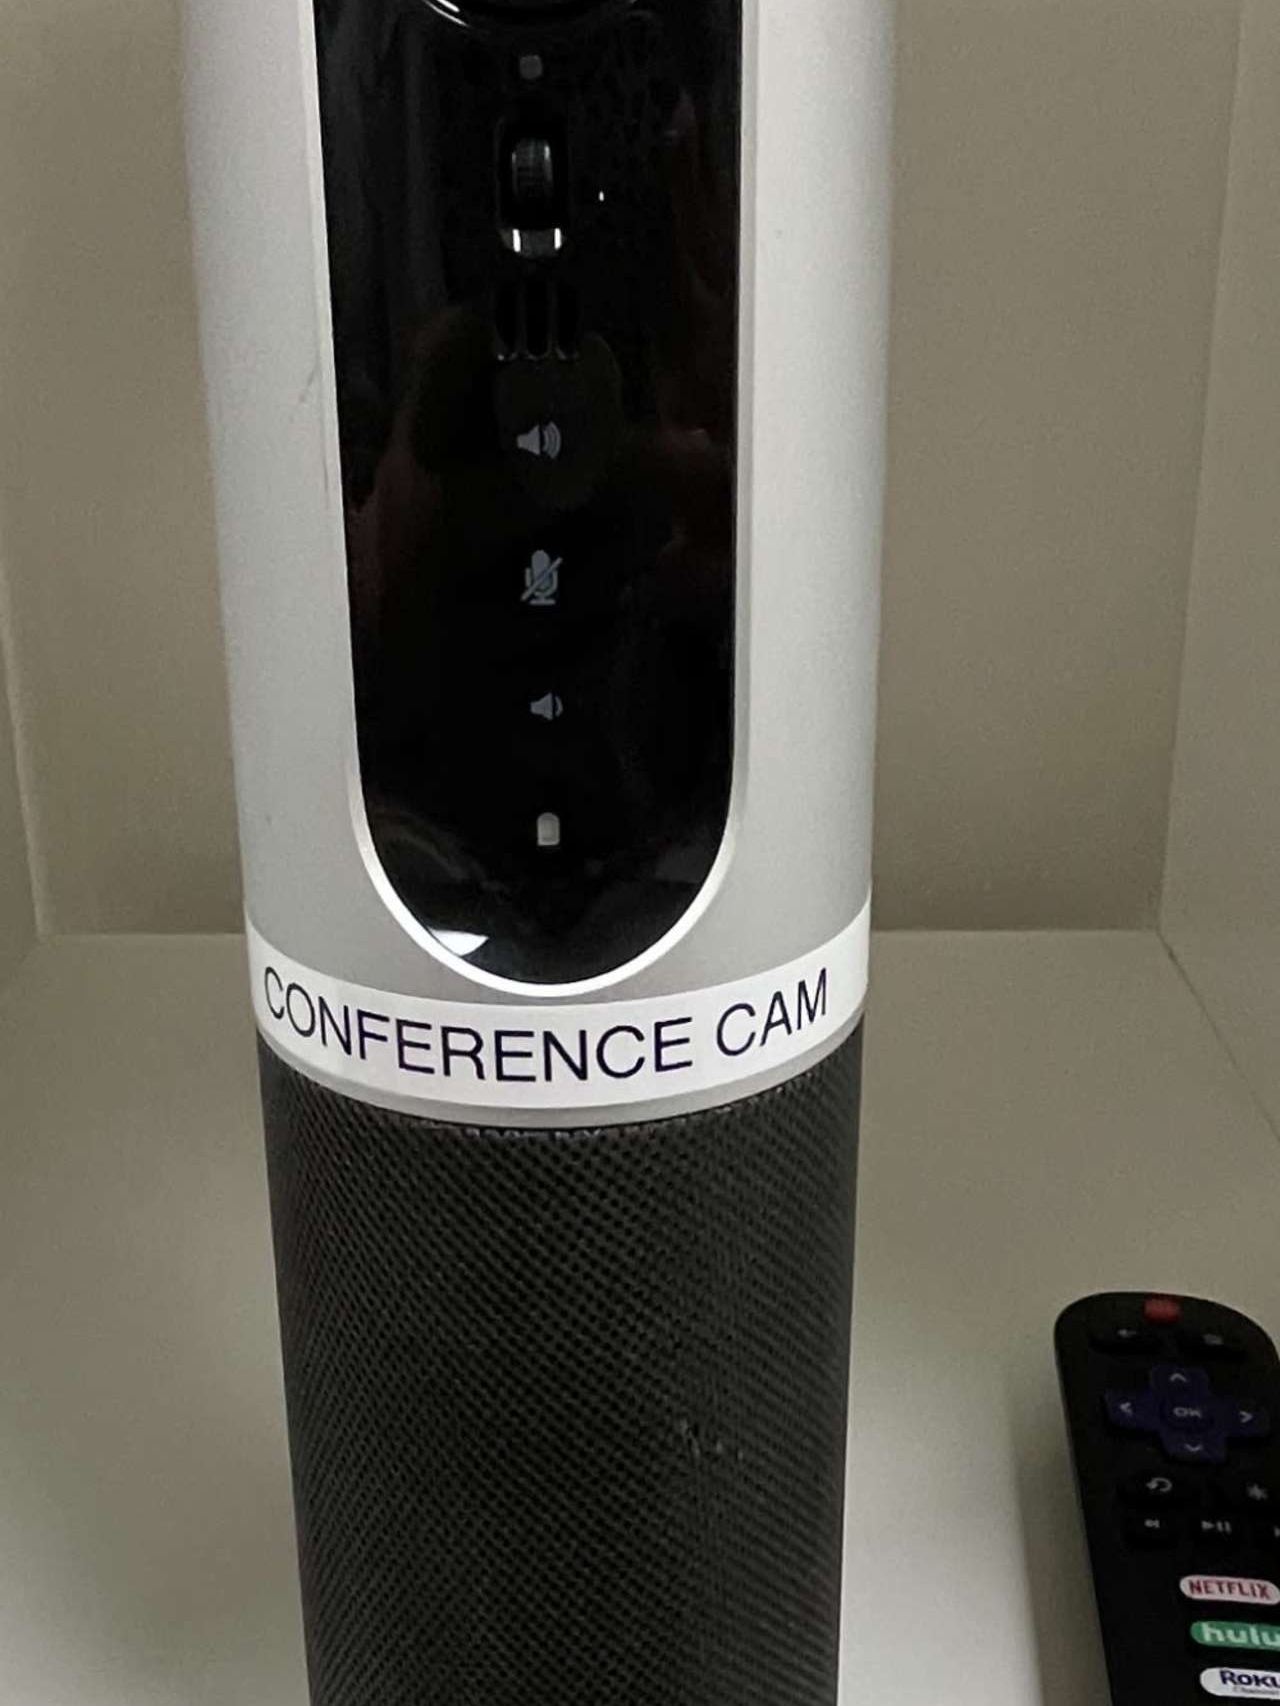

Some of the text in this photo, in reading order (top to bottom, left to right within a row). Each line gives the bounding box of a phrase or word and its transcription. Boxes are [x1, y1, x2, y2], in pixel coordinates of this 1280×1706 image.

[264, 966, 828, 1083] CONFERENCE CAM
[1174, 1406, 1202, 1417] OK
[1188, 1579, 1271, 1600] NETFLIX
